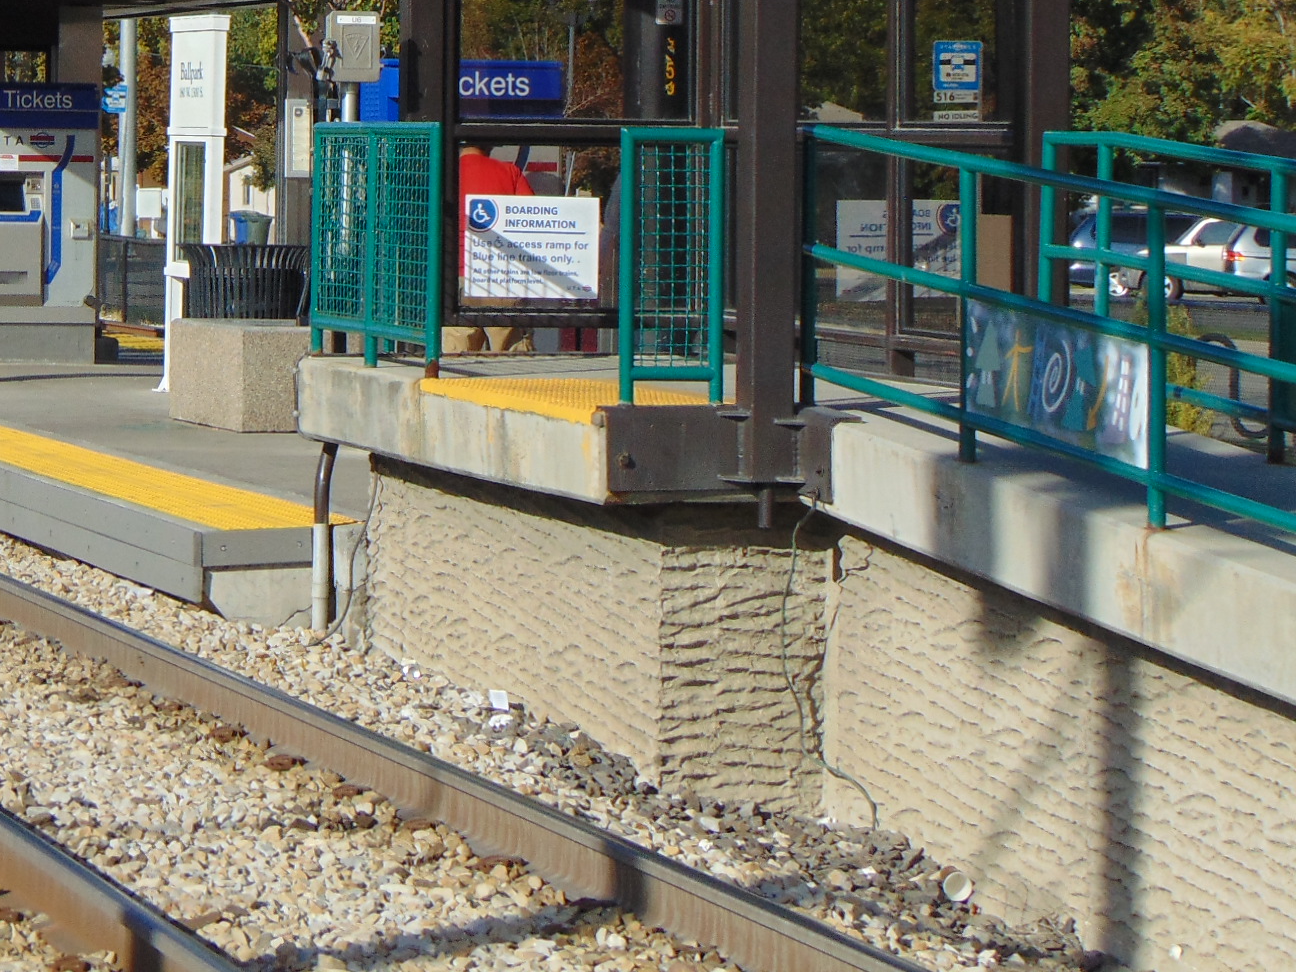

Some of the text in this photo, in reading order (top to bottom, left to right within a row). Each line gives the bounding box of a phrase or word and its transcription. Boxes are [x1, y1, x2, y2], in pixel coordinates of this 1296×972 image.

[180, 61, 204, 85] Ballpark
[459, 70, 530, 97] ckets
[3, 89, 73, 109] Tickets
[936, 92, 955, 102] 516
[938, 112, 979, 121] NO IDLING
[505, 205, 559, 216] BOARDING
[505, 218, 577, 229] INFORMATION
[472, 238, 589, 251] Use access ramp for
[472, 251, 495, 261] Blue
[497, 252, 516, 262] line
[518, 252, 548, 263] trains
[499, 277, 527, 285] platform
